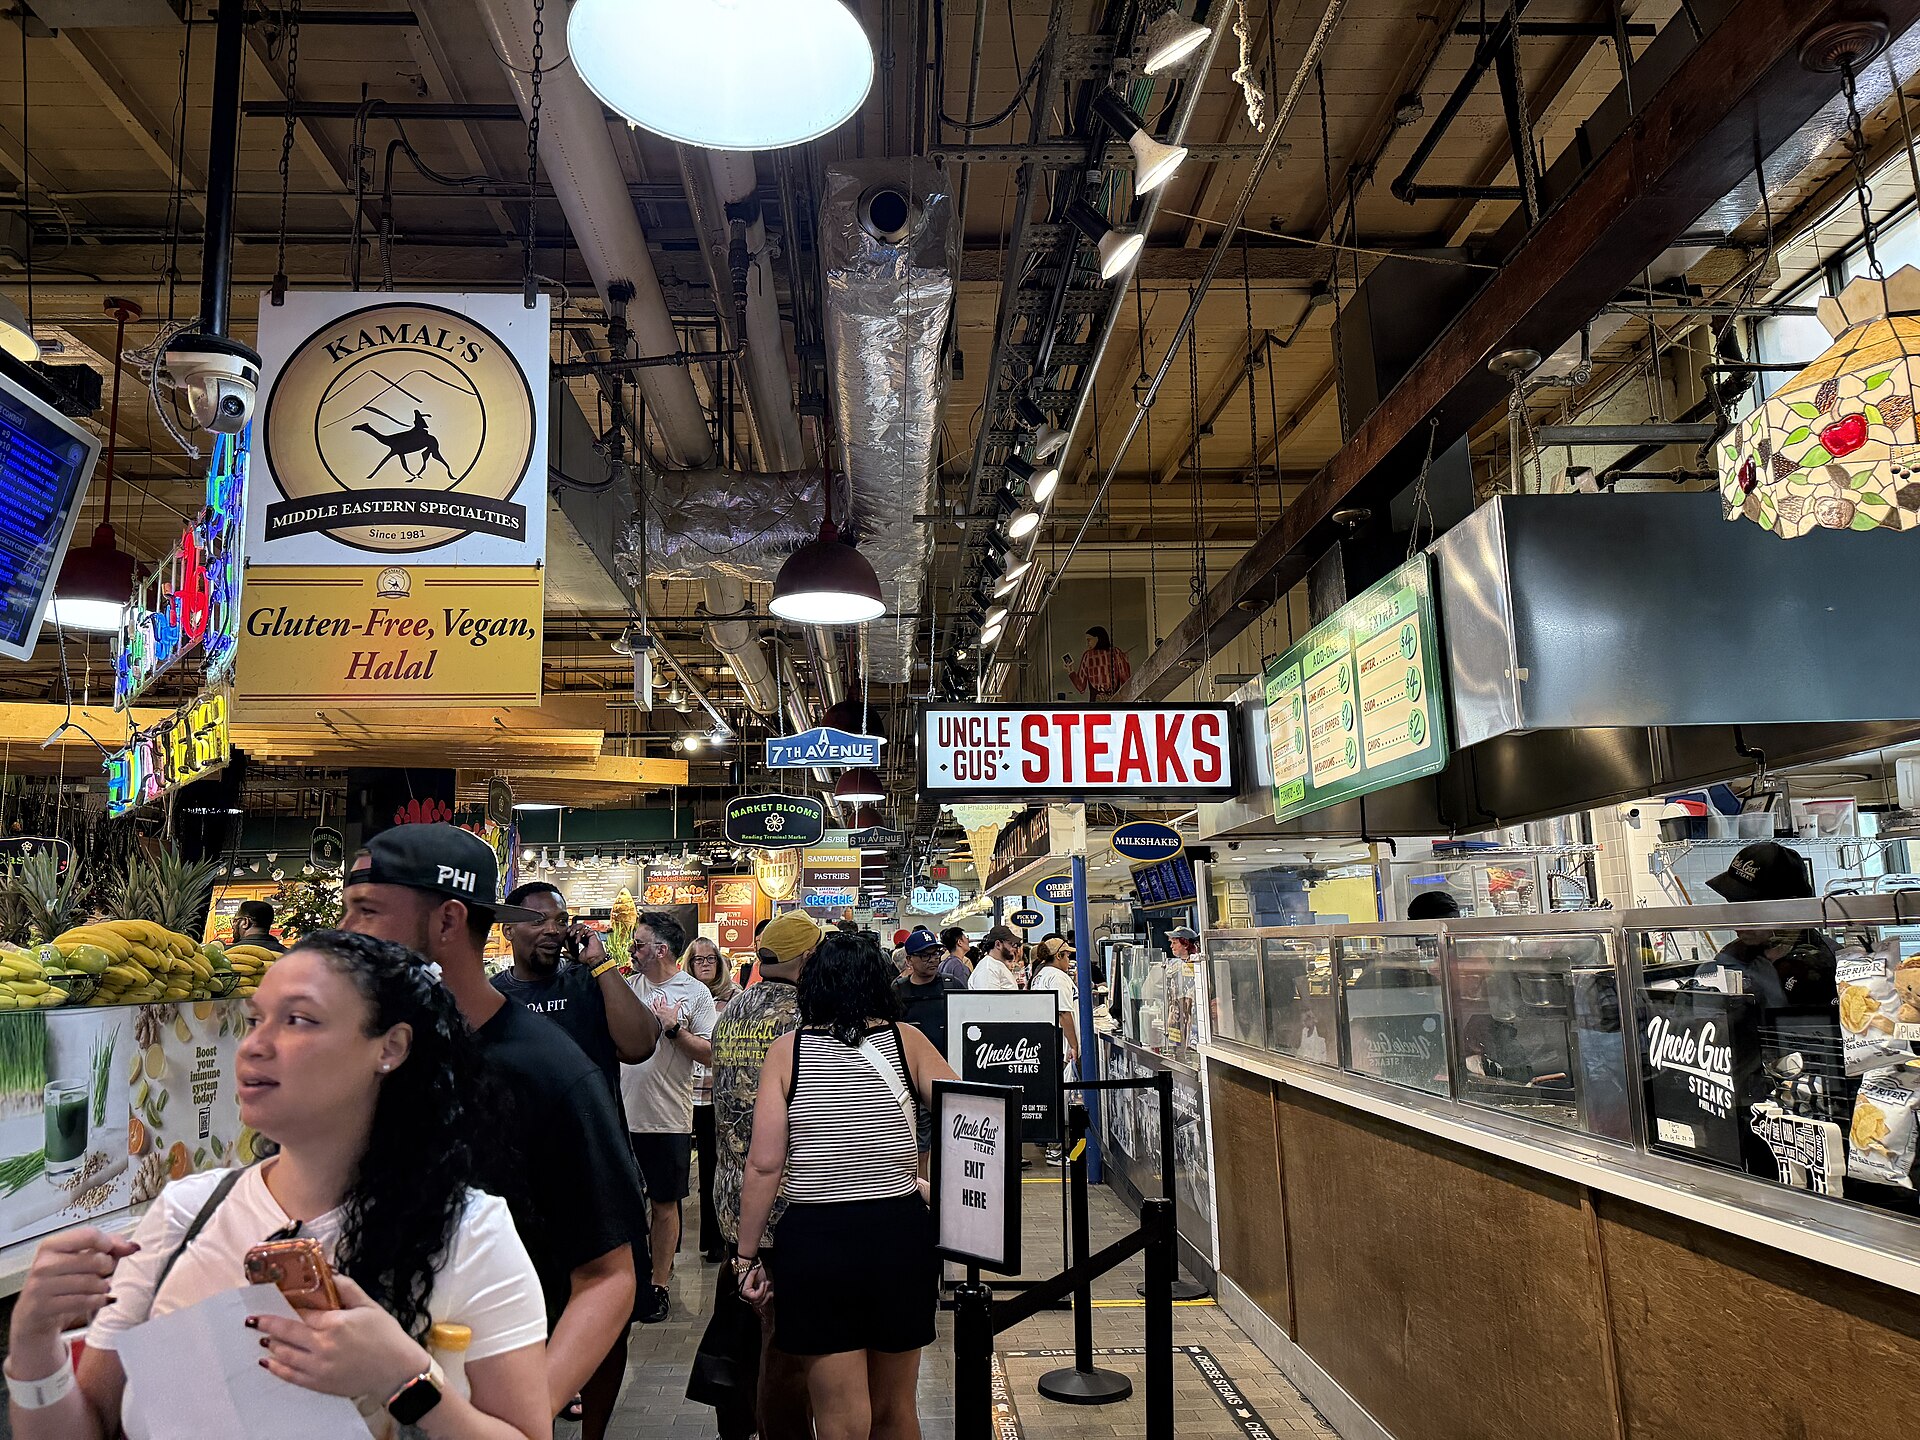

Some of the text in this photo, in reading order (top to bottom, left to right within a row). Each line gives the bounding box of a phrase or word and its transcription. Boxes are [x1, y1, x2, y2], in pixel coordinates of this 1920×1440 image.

[321, 323, 485, 364] KAMAL'S
[272, 500, 520, 529] MIDDLE EASTERN SPECIALTIES
[368, 528, 426, 540] Since 1981
[246, 606, 536, 647] Gluten-Free, Vegan,
[344, 649, 438, 681] Halal
[1363, 695, 1376, 713] SODA
[938, 716, 1010, 748] UNCLE
[1409, 714, 1421, 738] $2
[818, 728, 829, 746] A
[805, 744, 873, 758] AVENUE
[1020, 713, 1223, 784] STEAKS
[953, 750, 1004, 781] GUS'
[730, 803, 819, 820] MARKET BLOOMS
[867, 834, 902, 843] AVENUE
[1115, 836, 1179, 846] MILKSHAKES
[807, 855, 856, 863] SANDWICHES
[437, 864, 477, 893] PHI
[679, 869, 701, 877] Delivery
[760, 863, 795, 879] BAKERY
[814, 872, 850, 880] PASTRIES
[1045, 883, 1073, 891] ORDER
[1050, 890, 1072, 898] HERE
[804, 894, 853, 907] CREPERIE
[916, 891, 954, 903] PEARL'S
[716, 919, 749, 927] PANINIS
[1837, 962, 1882, 978] EEP RIVER
[546, 998, 568, 1012] FIT
[195, 1045, 217, 1058] Boost
[975, 1037, 1042, 1069] Uncle Gus'
[1647, 1015, 1732, 1076] Uncle Gus
[1845, 1040, 1867, 1051] Sea Salt
[197, 1059, 215, 1072] your
[1008, 1064, 1039, 1074] STEAKS
[190, 1068, 220, 1082] immune
[192, 1080, 218, 1095] system
[1688, 1075, 1732, 1110] STEAKS
[1876, 1087, 1907, 1101] RIVER
[193, 1090, 217, 1105] today!
[1717, 1107, 1726, 1119] PA
[952, 1113, 999, 1141] Uncle Gus'
[973, 1141, 995, 1156] STEAKS
[964, 1159, 985, 1180] EXIT
[962, 1188, 987, 1210] HERE
[1039, 1346, 1182, 1356] CHESE STES
[1195, 1355, 1243, 1405] CHEESE STEAKS
